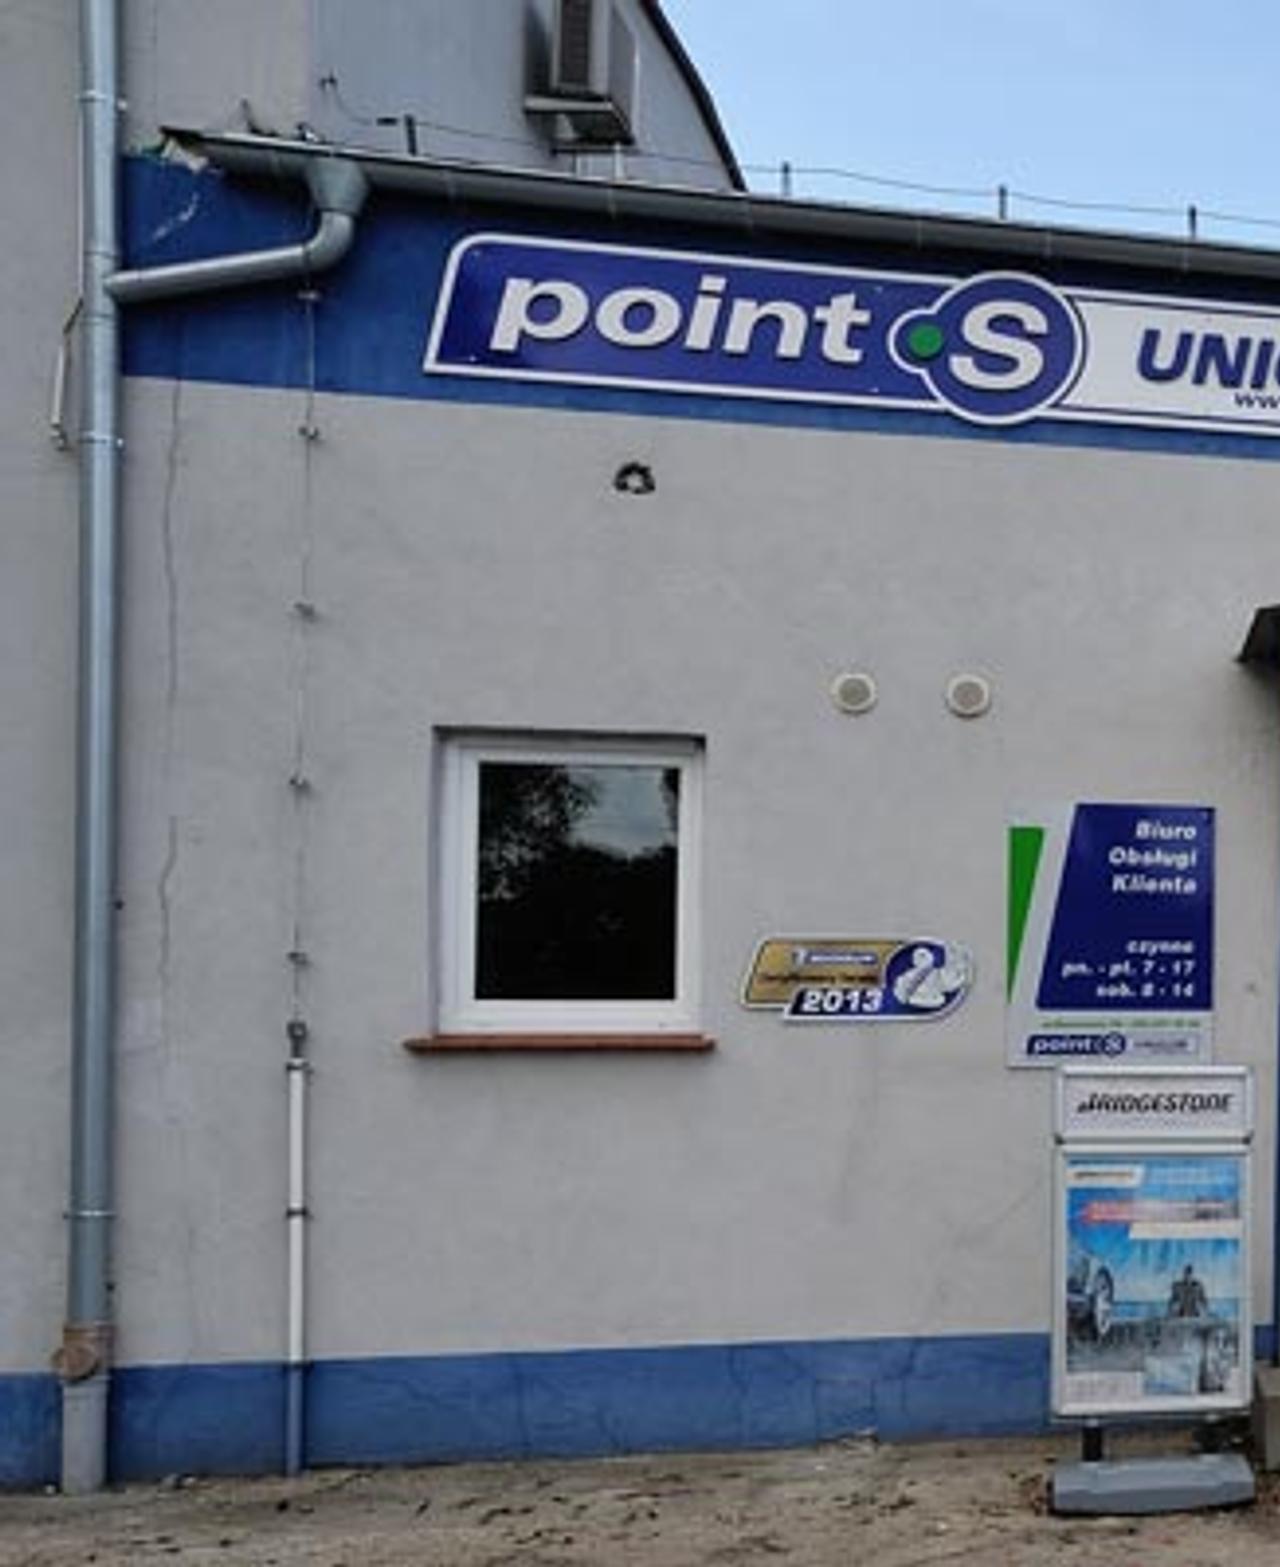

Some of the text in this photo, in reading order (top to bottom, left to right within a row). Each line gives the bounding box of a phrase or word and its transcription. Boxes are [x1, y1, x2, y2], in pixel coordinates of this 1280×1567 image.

[489, 275, 1049, 391] point S
[1136, 819, 1197, 840] Biuro
[1112, 873, 1197, 894] Klienta
[1143, 960, 1156, 975] 7
[1172, 960, 1195, 976] 17
[802, 989, 883, 1012] 2013
[1172, 983, 1194, 997] 14
